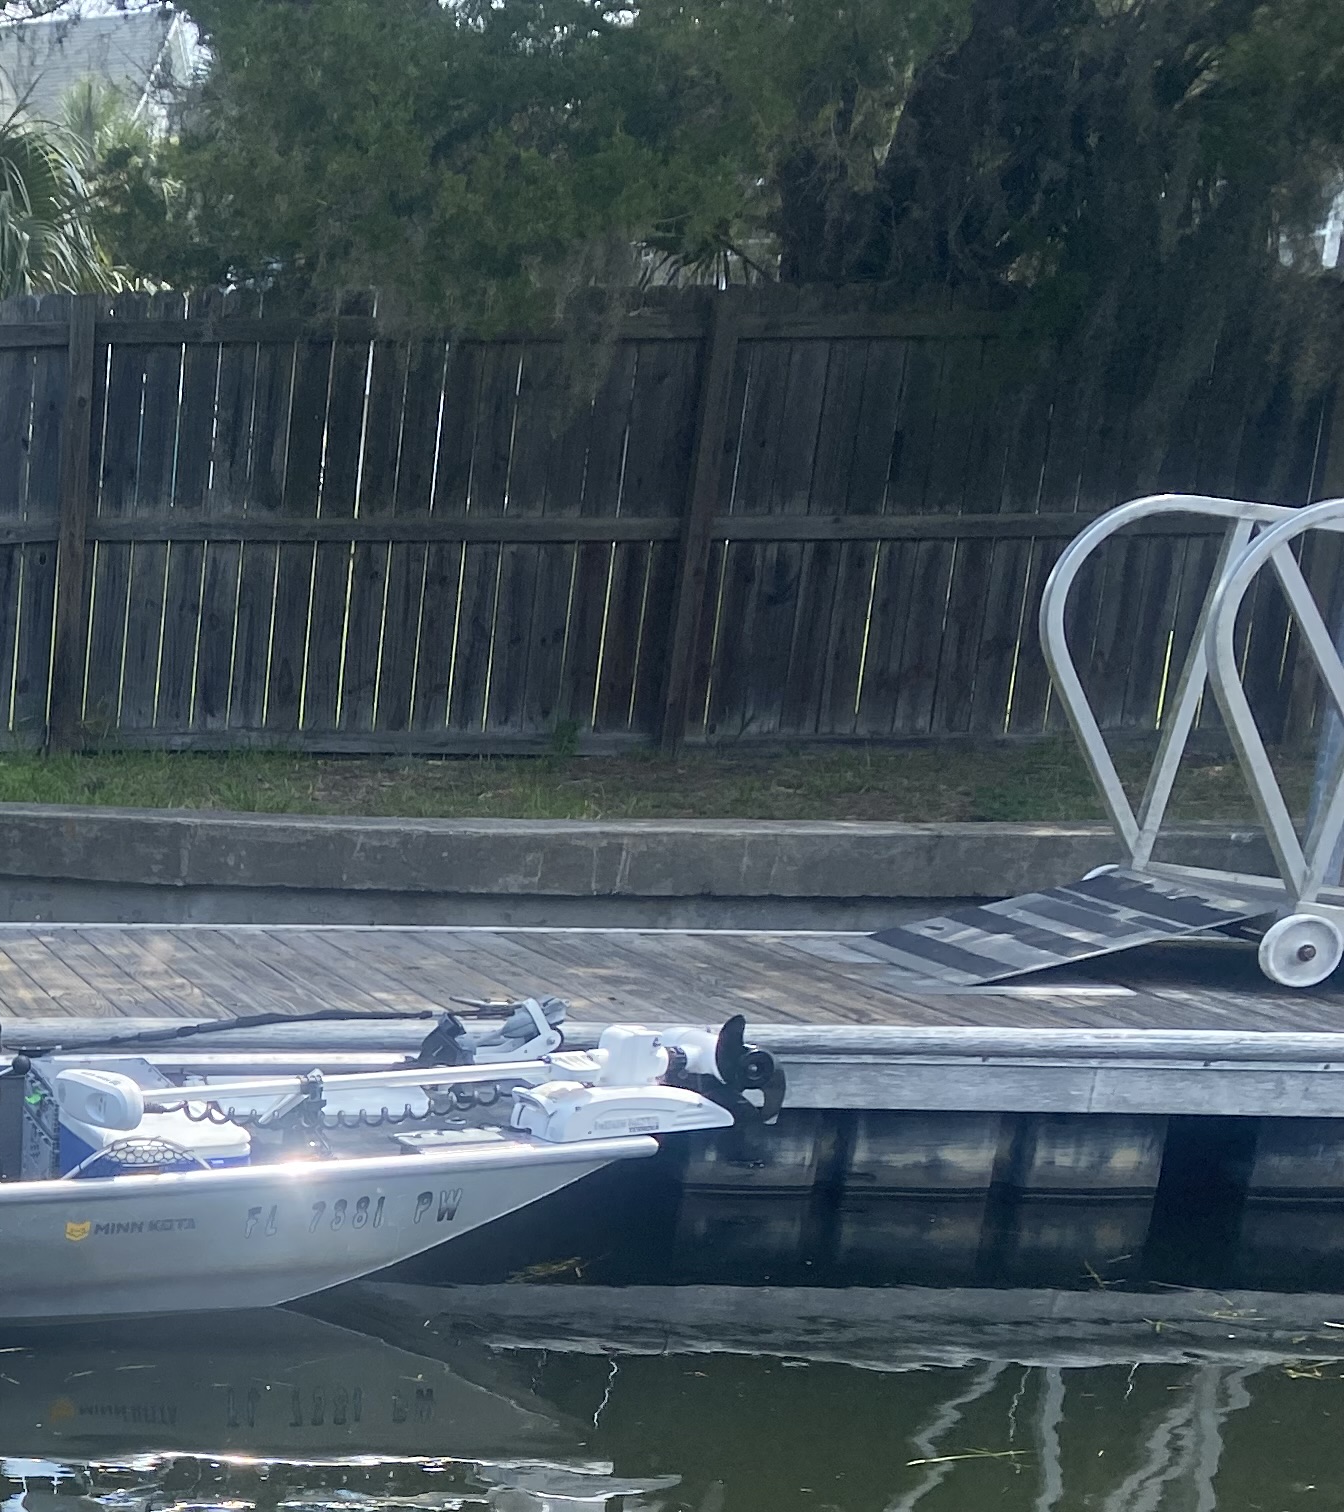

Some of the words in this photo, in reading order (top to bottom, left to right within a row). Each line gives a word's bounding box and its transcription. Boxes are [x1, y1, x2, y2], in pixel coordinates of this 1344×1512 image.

[94, 1222, 144, 1235] MINN
[244, 1204, 278, 1239] FL
[413, 1188, 463, 1224] PW
